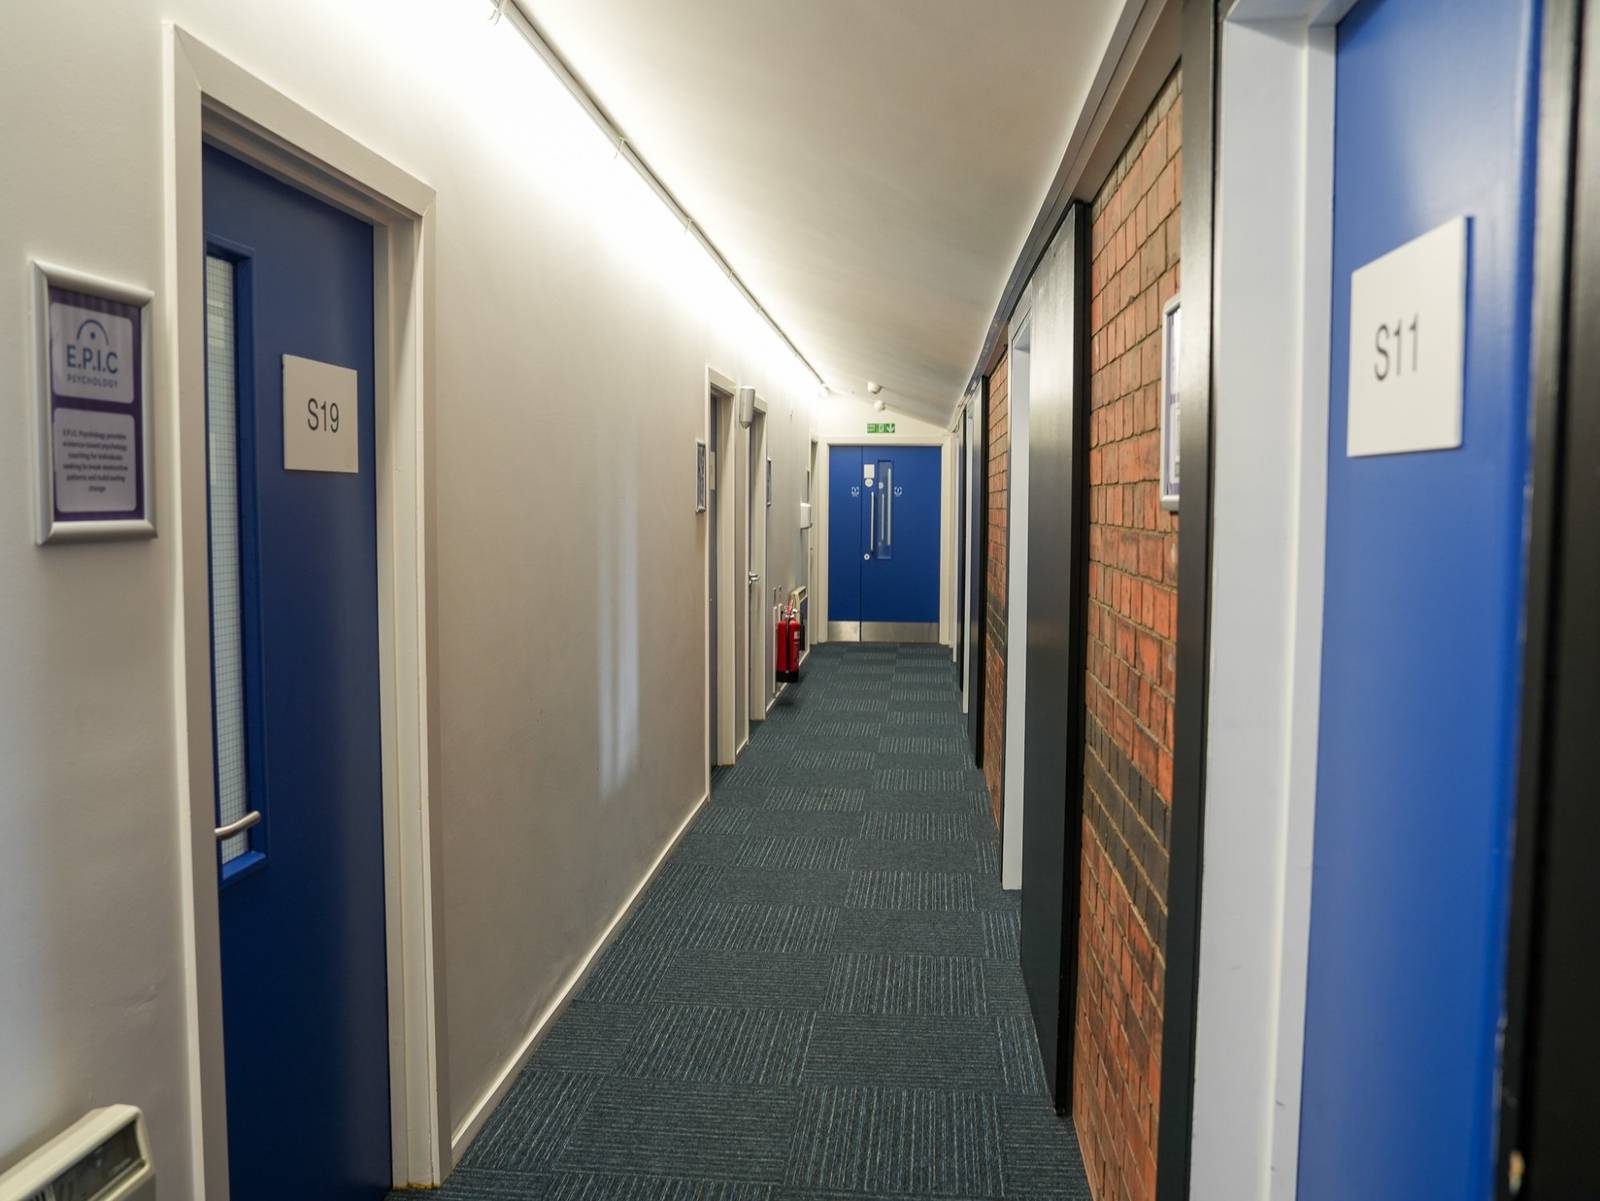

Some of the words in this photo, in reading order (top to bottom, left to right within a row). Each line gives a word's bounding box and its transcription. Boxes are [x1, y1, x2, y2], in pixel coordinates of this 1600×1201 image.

[66, 344, 118, 375] E.P.I.C
[1374, 313, 1419, 382] S11
[66, 373, 118, 388] PSYCHOLOGY
[307, 398, 340, 433] S19
